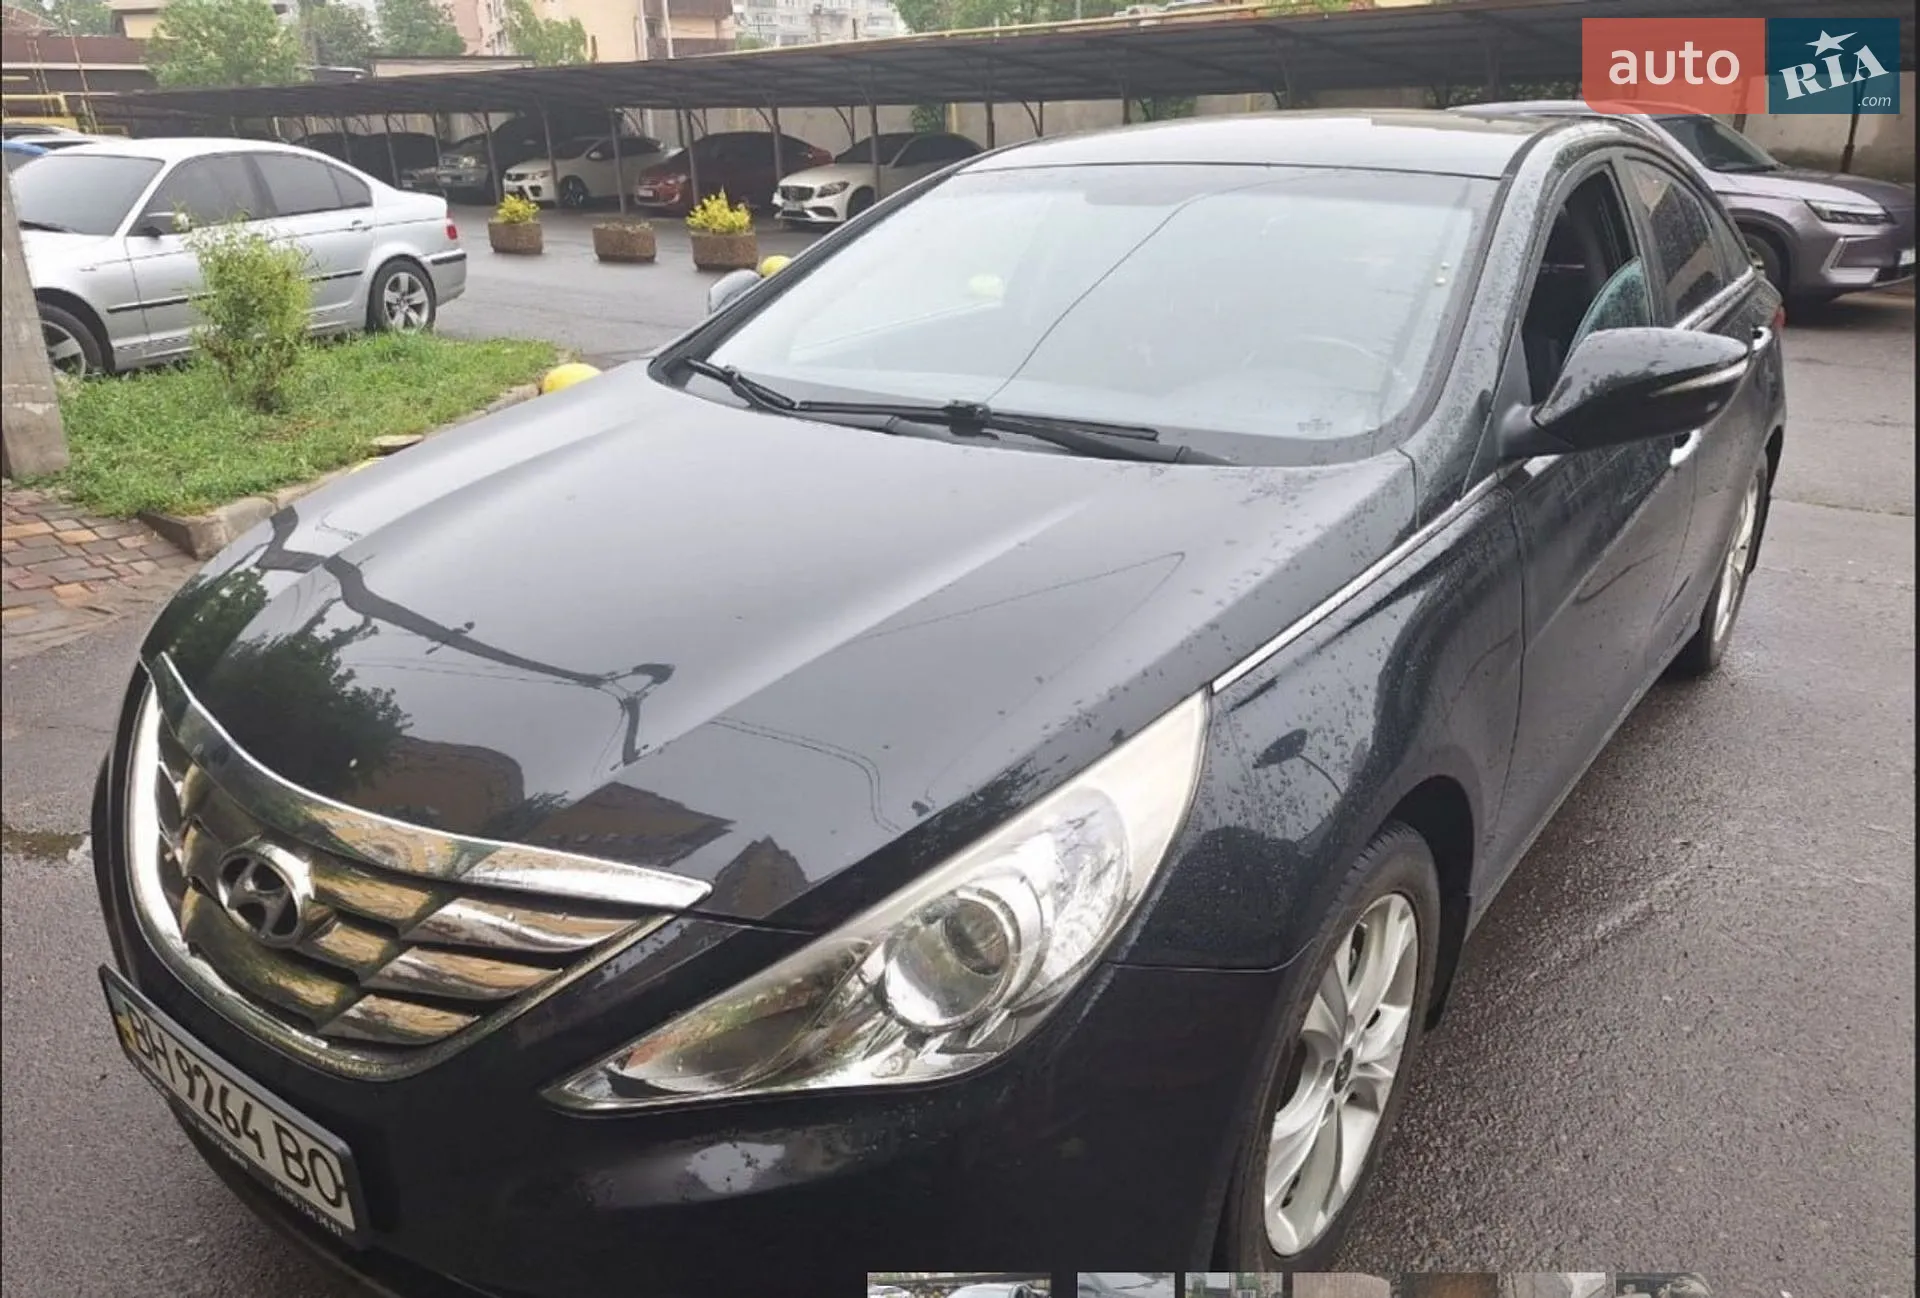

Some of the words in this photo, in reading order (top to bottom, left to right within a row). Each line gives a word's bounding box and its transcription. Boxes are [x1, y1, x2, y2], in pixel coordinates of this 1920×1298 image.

[124, 1002, 176, 1083] BH
[176, 1049, 266, 1160] 9264
[273, 1121, 344, 1209] BO
